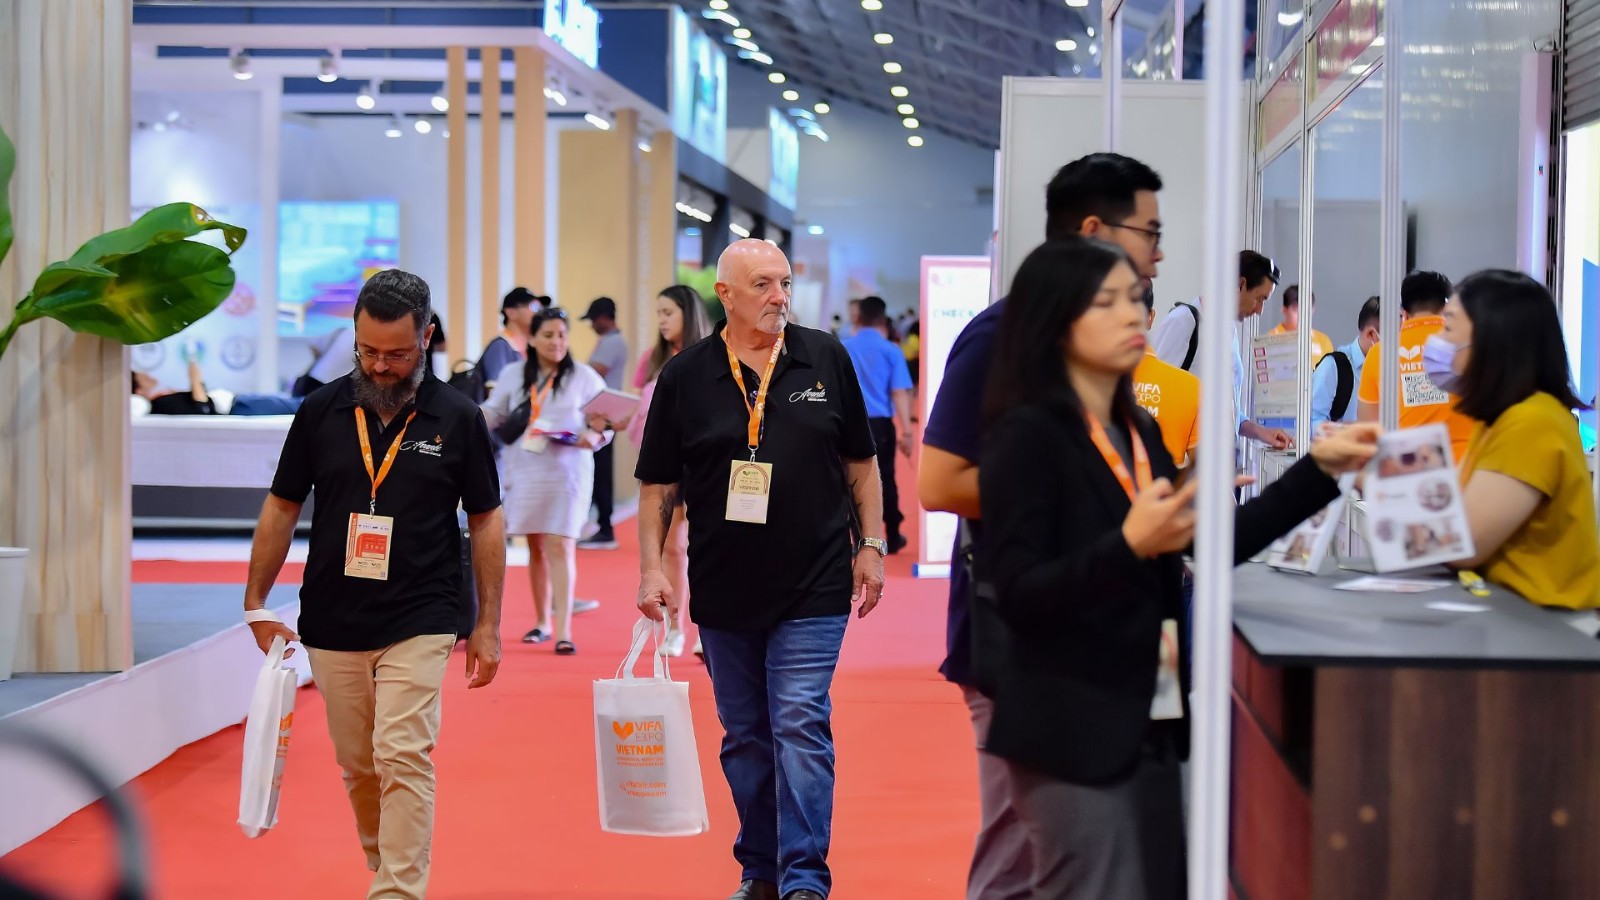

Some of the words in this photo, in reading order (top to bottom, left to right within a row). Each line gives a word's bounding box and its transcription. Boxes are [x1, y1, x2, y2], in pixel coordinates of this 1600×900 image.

[1132, 382, 1161, 394] VIFA
[634, 720, 663, 732] VIFA
[635, 732, 664, 742] EXPO
[616, 744, 665, 755] VIETNAM
